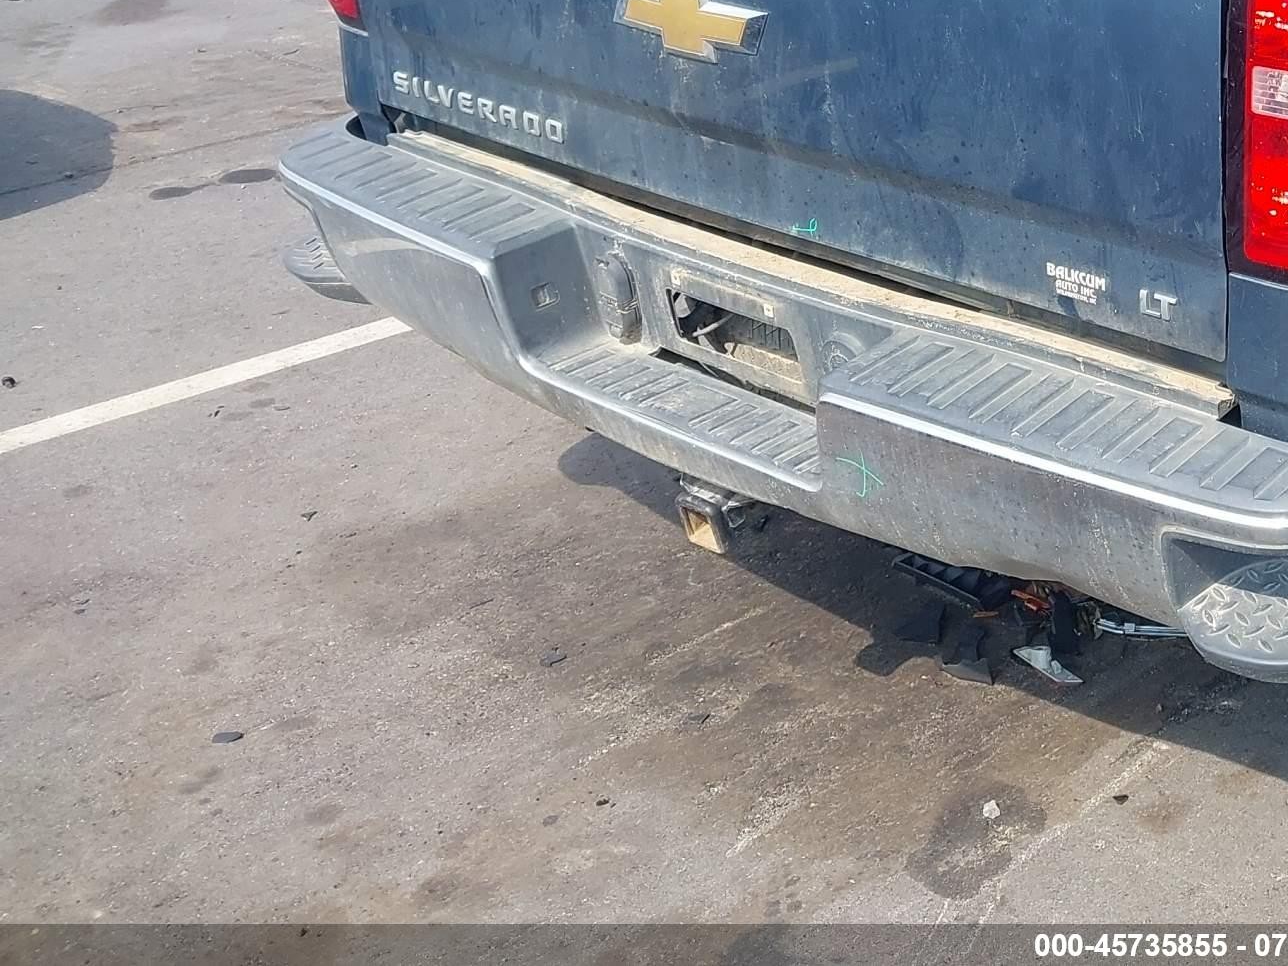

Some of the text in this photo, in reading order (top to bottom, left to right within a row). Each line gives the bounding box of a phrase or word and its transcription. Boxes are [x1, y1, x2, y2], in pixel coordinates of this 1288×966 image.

[392, 70, 564, 144] SILVERADO
[1046, 262, 1106, 292] BALKCUM
[1055, 279, 1079, 293] AUTO
[1139, 289, 1178, 321] LT
